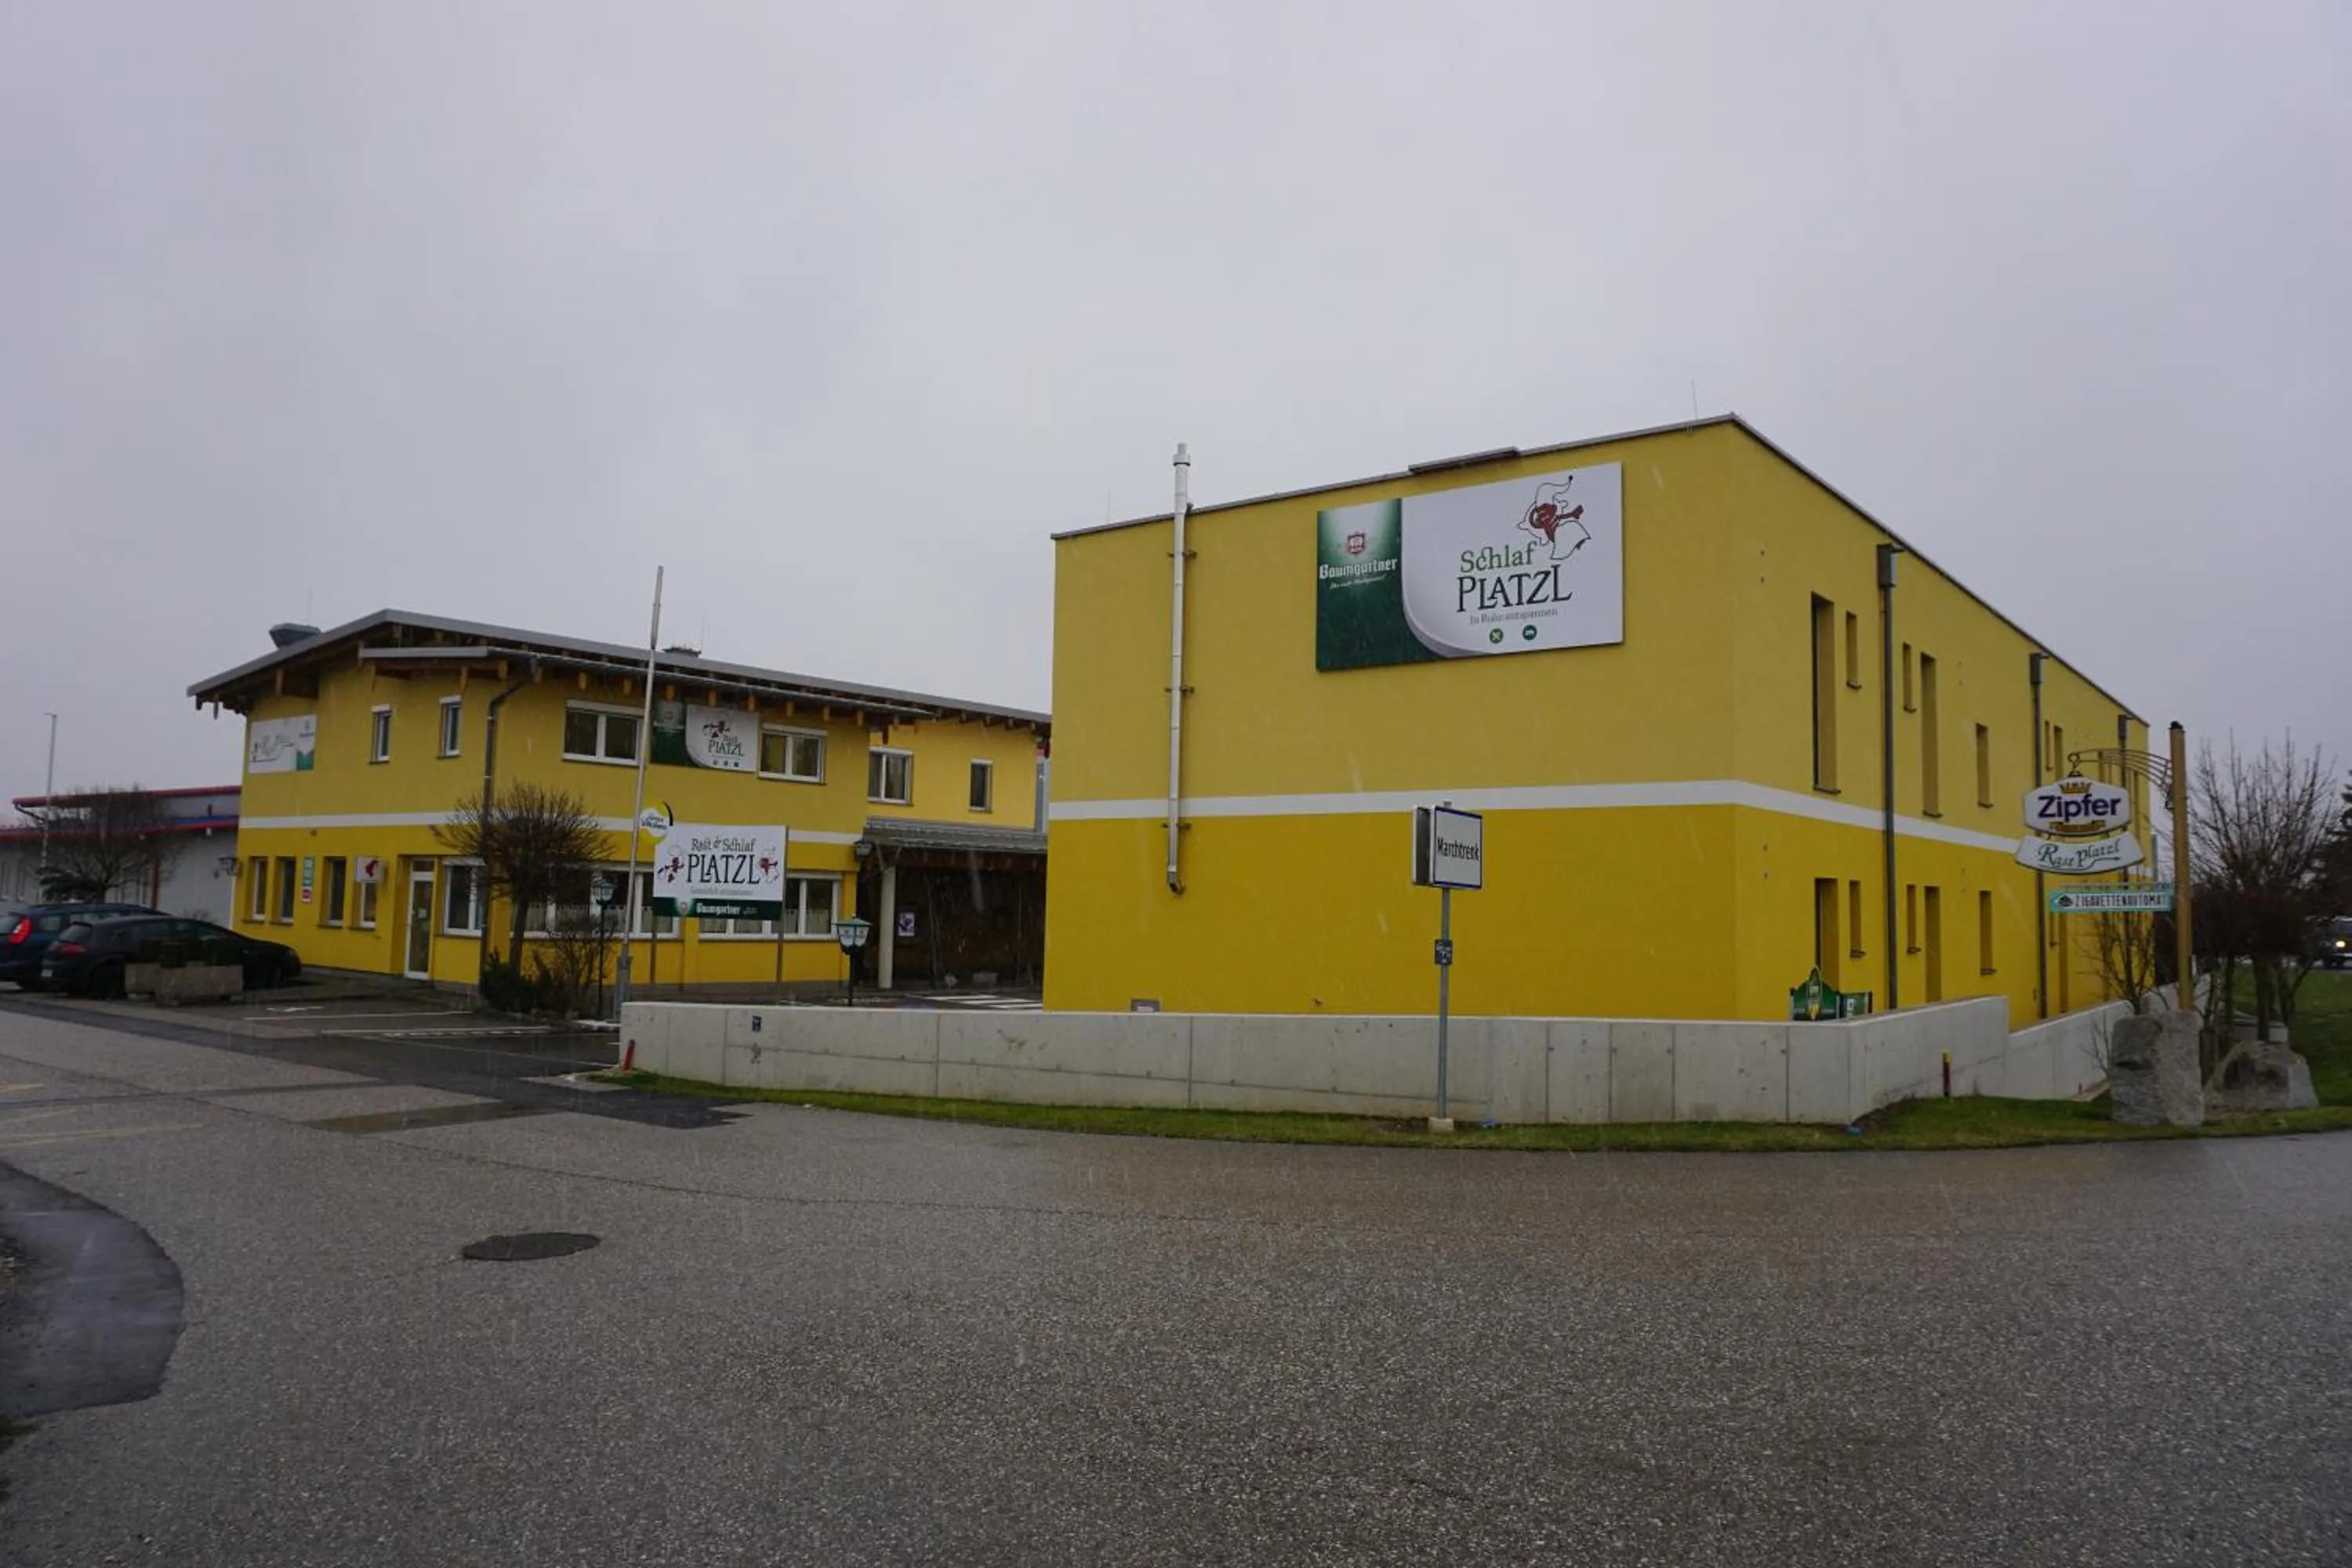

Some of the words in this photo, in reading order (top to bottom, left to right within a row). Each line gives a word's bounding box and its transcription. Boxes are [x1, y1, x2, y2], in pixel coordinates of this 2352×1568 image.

[1319, 558, 1398, 579] Baumgartner
[1461, 541, 1537, 573] Schlaf
[1457, 564, 1573, 612] PLATZL
[2038, 793, 2122, 822] Zipfer
[691, 838, 712, 851] Rast
[722, 838, 757, 852] Schlaf
[687, 854, 760, 885] PLATZL
